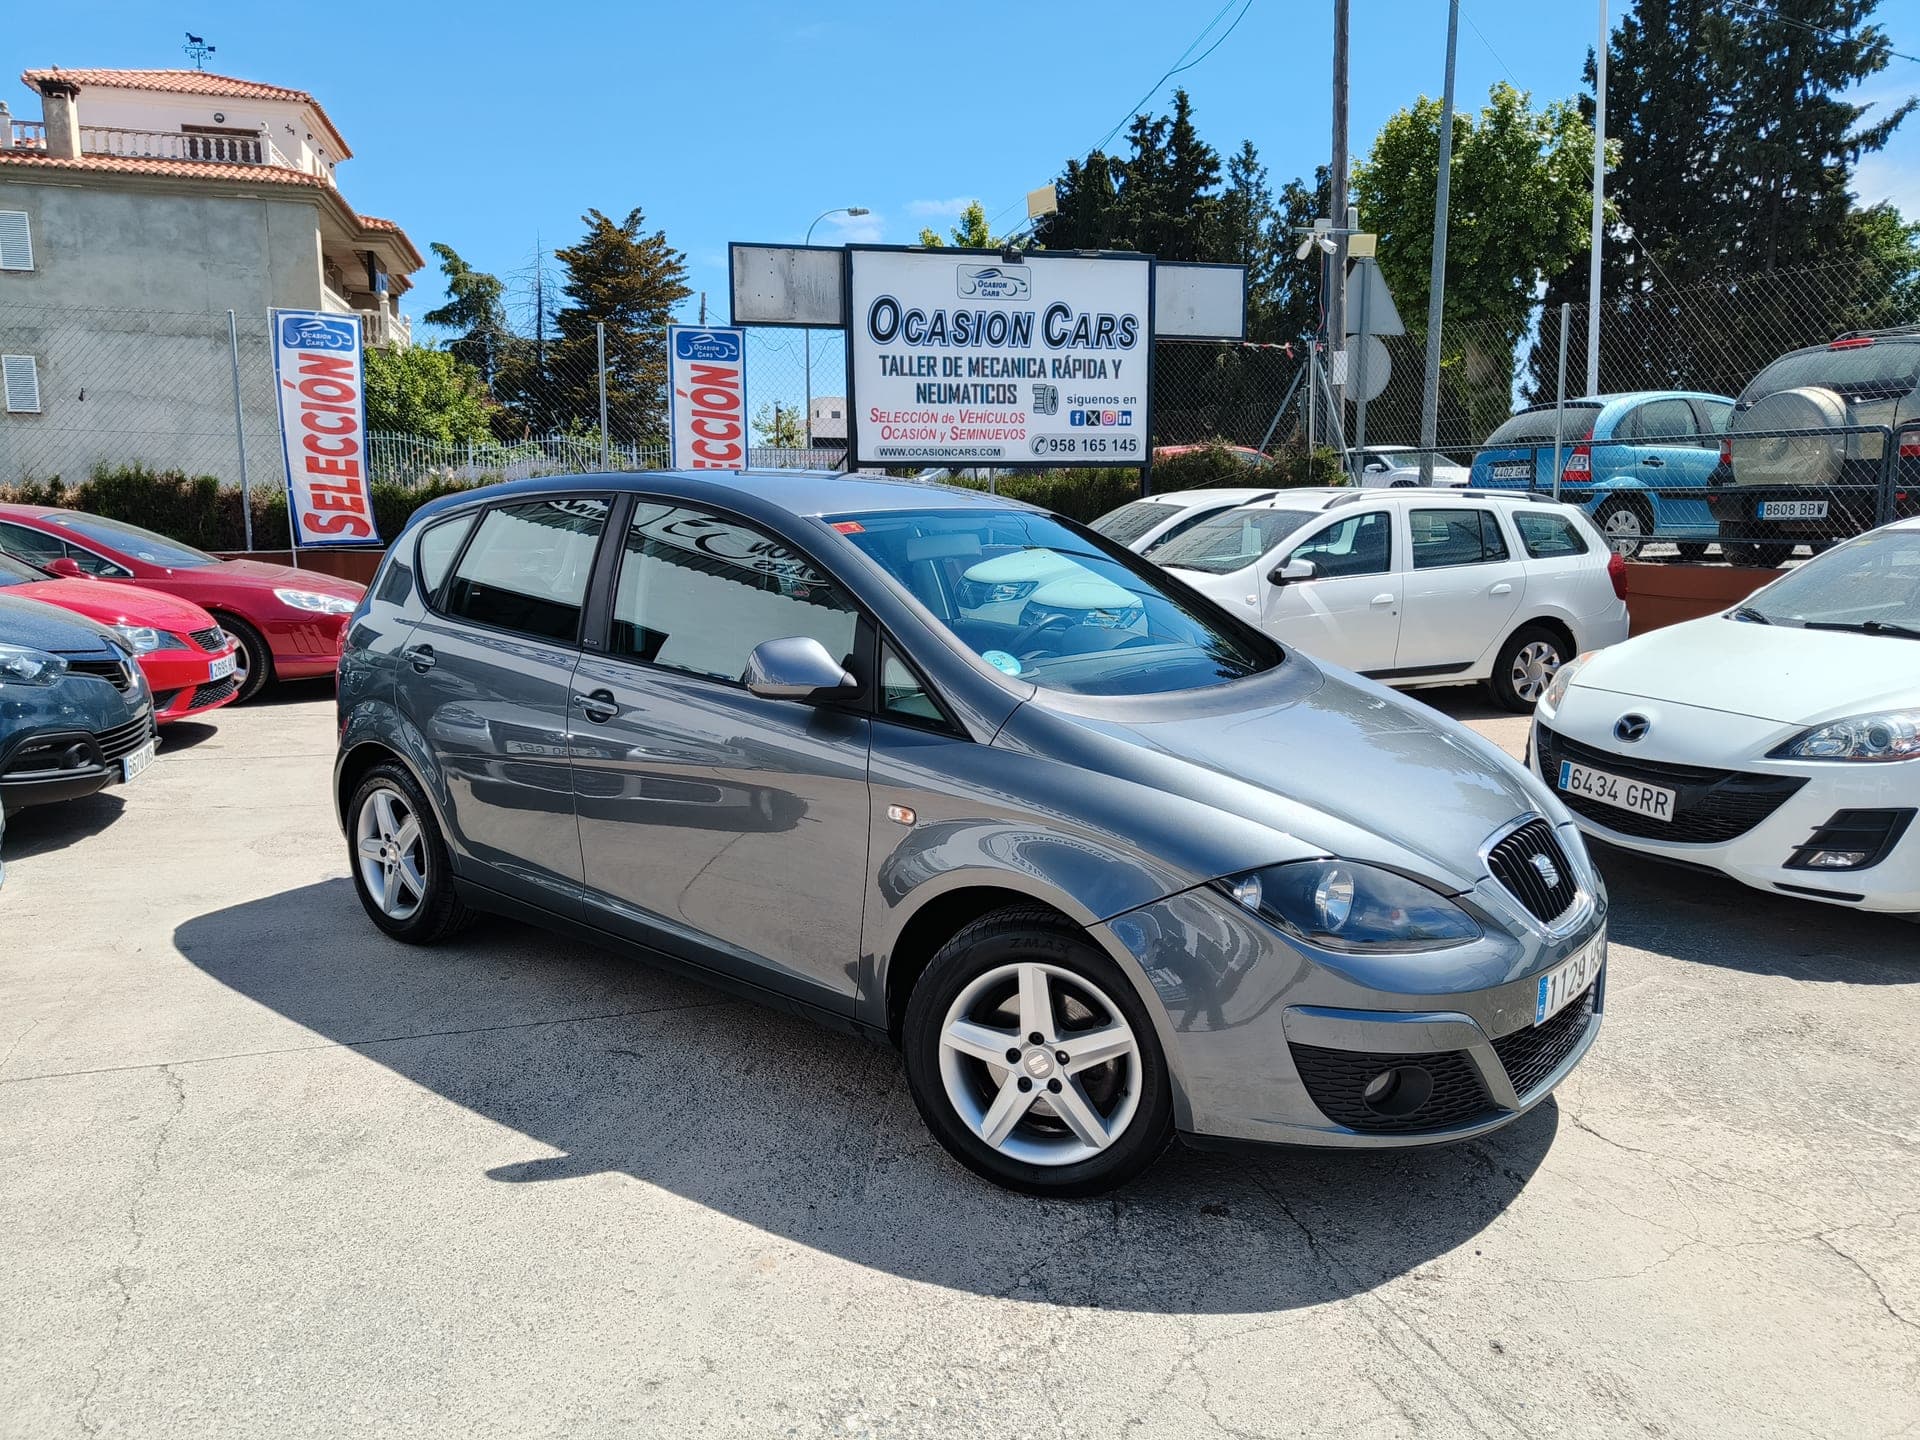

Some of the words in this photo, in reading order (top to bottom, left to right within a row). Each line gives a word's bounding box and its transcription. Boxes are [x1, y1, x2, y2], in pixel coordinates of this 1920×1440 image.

[867, 294, 1035, 348] OCASION
[1042, 301, 1139, 350] CARS
[879, 355, 937, 377] TALLER
[943, 356, 963, 378] DE
[968, 357, 1047, 379] MECANICA
[1052, 355, 1108, 380] RÁPIDA
[1111, 359, 1122, 380] Y
[916, 383, 1018, 405] NEUMATICOS
[1123, 396, 1137, 405] en
[870, 407, 938, 424] SELECCIÓN
[942, 412, 955, 424] de
[959, 409, 1026, 425] VEHÍCULOS
[881, 425, 937, 441] OCASIÓN
[940, 431, 947, 443] y
[950, 426, 1026, 441] SEMINUEVOS
[283, 352, 370, 538] SELECCIÓN
[879, 447, 1001, 457] WWW.OCASIONCARS.COM
[1050, 438, 1076, 452] 958
[1081, 438, 1107, 452] 165
[1112, 438, 1137, 452] 145
[1766, 503, 1796, 516] 8608
[1571, 768, 1618, 802] 6434
[1626, 784, 1668, 817] GRR
[1550, 954, 1586, 1011] 1129
